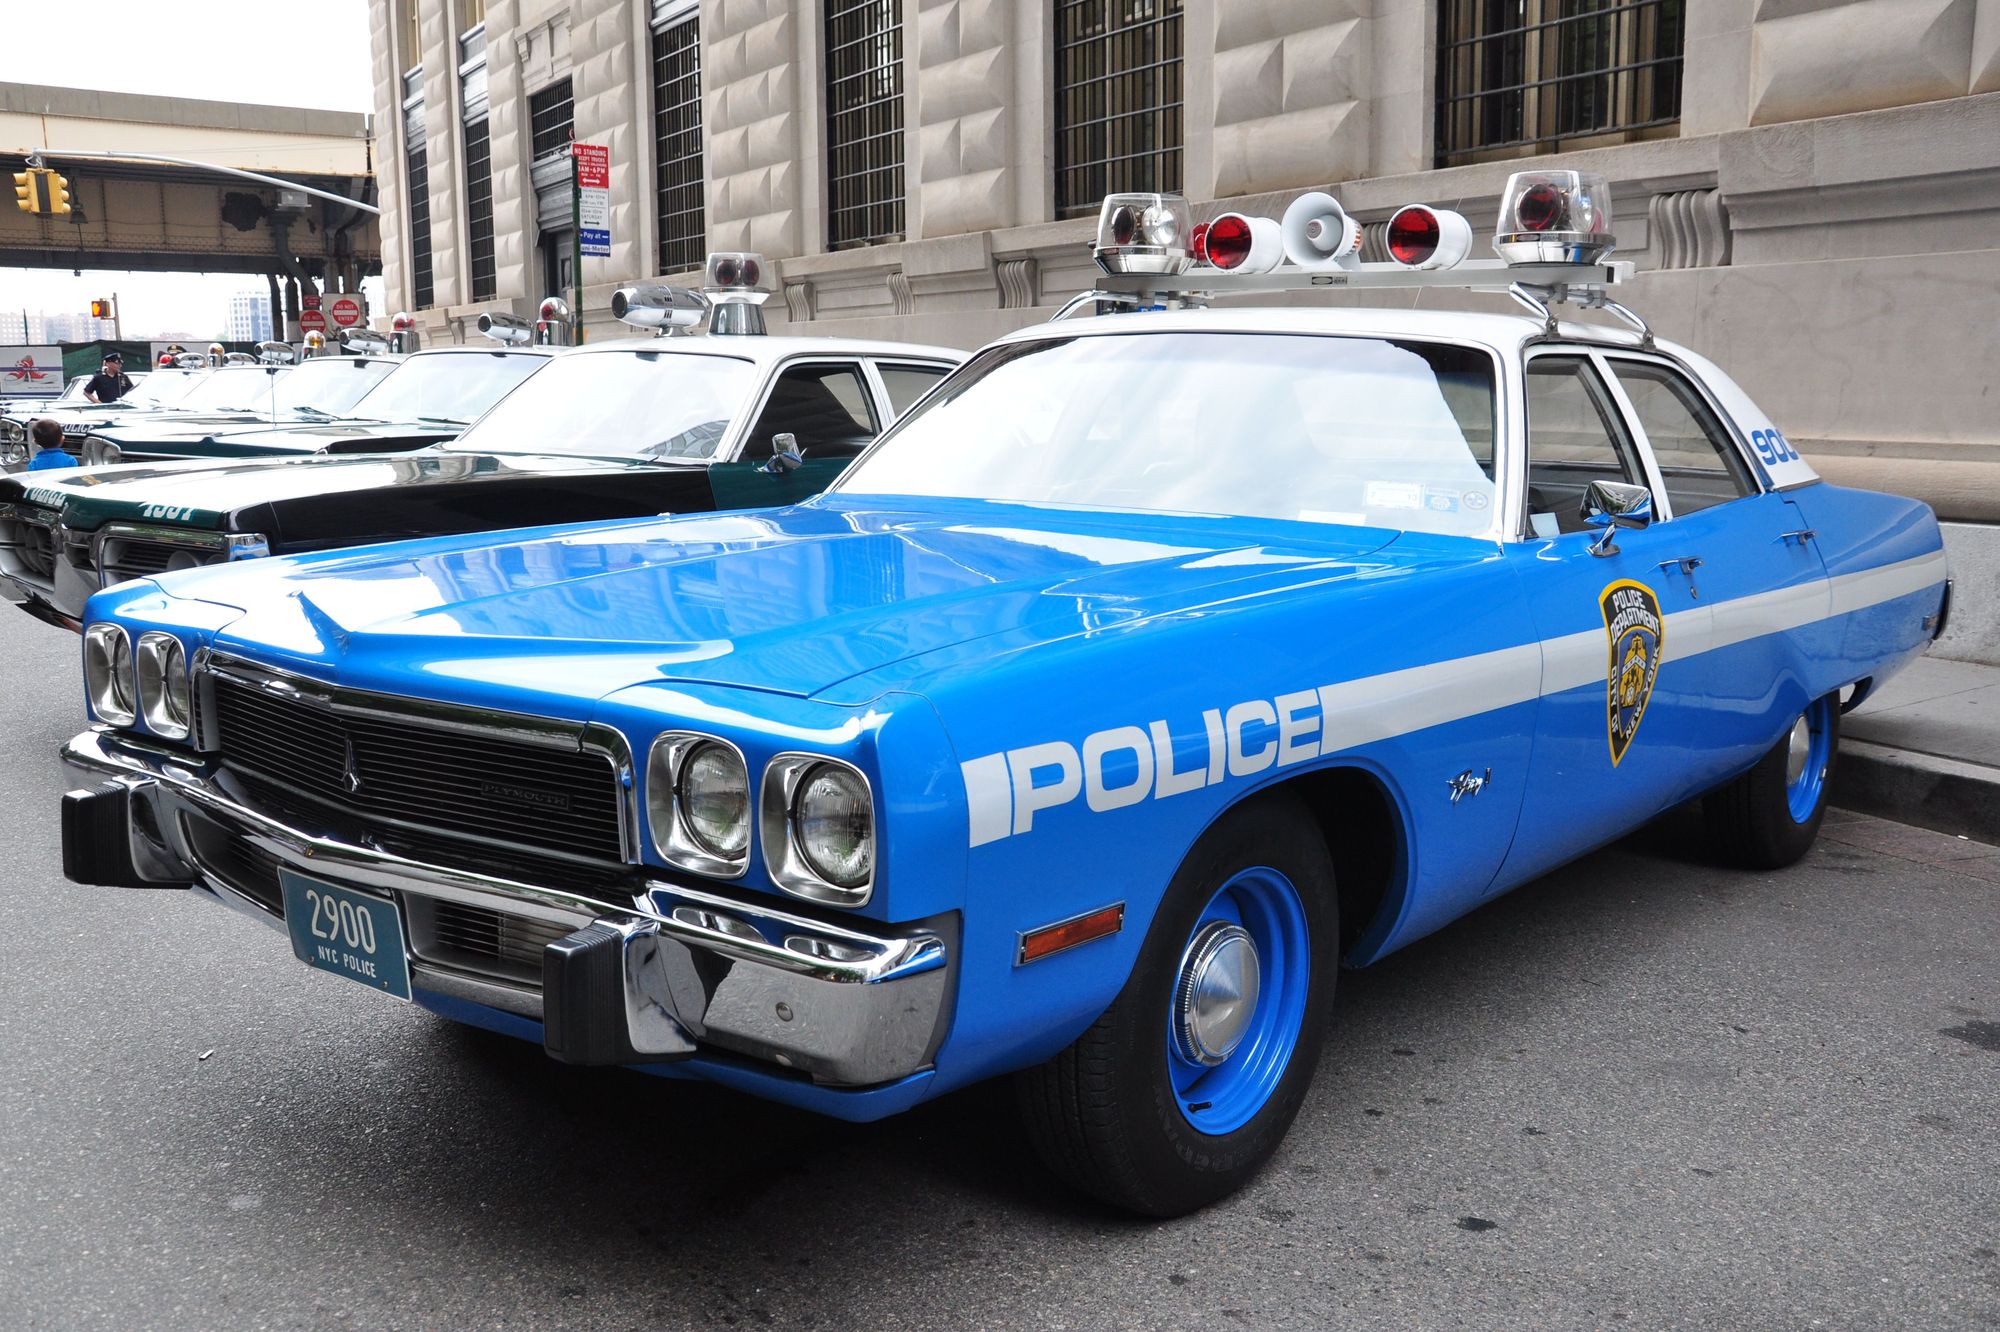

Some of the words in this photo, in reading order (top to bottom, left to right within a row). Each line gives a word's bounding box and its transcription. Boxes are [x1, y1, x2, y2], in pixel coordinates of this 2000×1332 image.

[574, 147, 582, 155] NO
[583, 148, 607, 157] STANDING
[583, 231, 594, 240] Pay
[581, 245, 608, 253] uni-Meter
[1612, 589, 1646, 613] POLICE
[1610, 608, 1660, 646] DEPARTMENT
[1625, 701, 1642, 740] NEW
[1644, 647, 1660, 693] YORK
[1611, 714, 1617, 733] OF
[1007, 688, 1321, 835] POLICE
[484, 784, 566, 806] PLYMOUTH
[306, 889, 376, 954] 2900
[318, 945, 338, 964] NYC
[343, 953, 377, 978] POLICE
